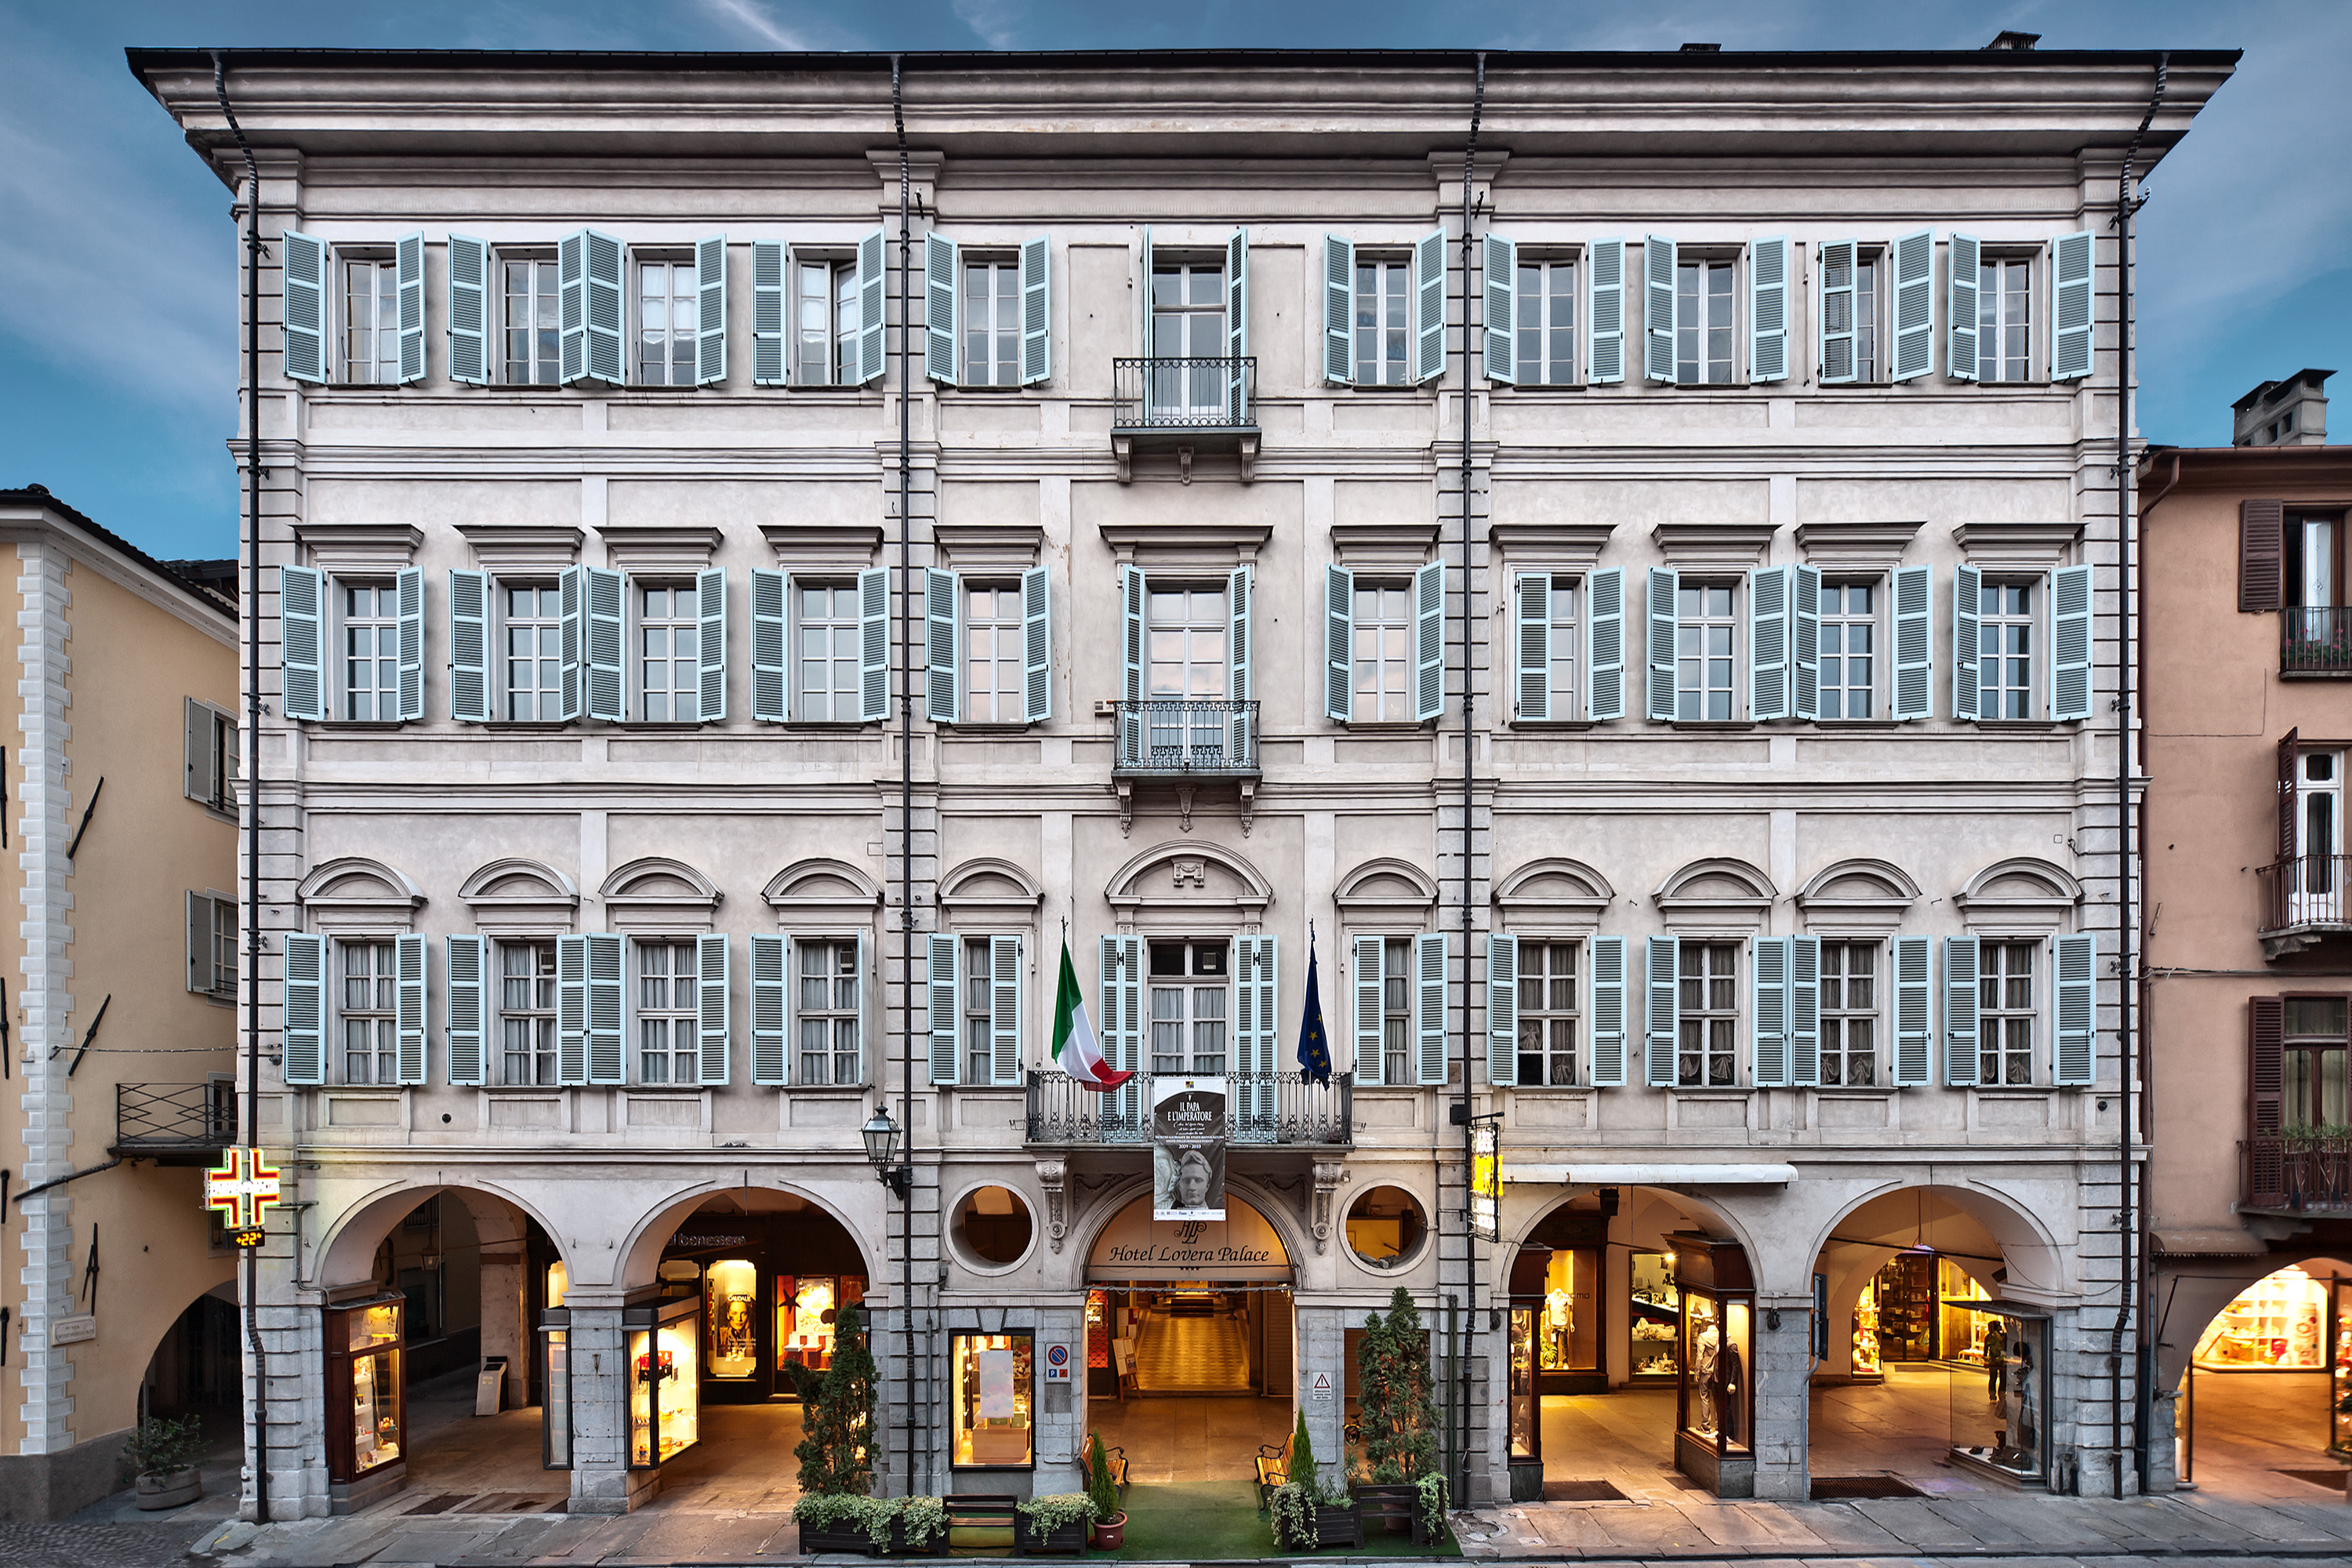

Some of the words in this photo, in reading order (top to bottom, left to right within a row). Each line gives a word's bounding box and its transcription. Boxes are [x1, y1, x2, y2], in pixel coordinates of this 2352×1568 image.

[1180, 1102, 1185, 1111] IL
[1186, 1102, 1200, 1111] PAPA
[1167, 1112, 1171, 1121] E
[1172, 1111, 1212, 1121] L'IMPERATORE
[678, 1232, 746, 1247] benessere
[1109, 1244, 1156, 1261] Hotel
[1158, 1247, 1214, 1261] Lovera
[1218, 1245, 1269, 1261] Palace
